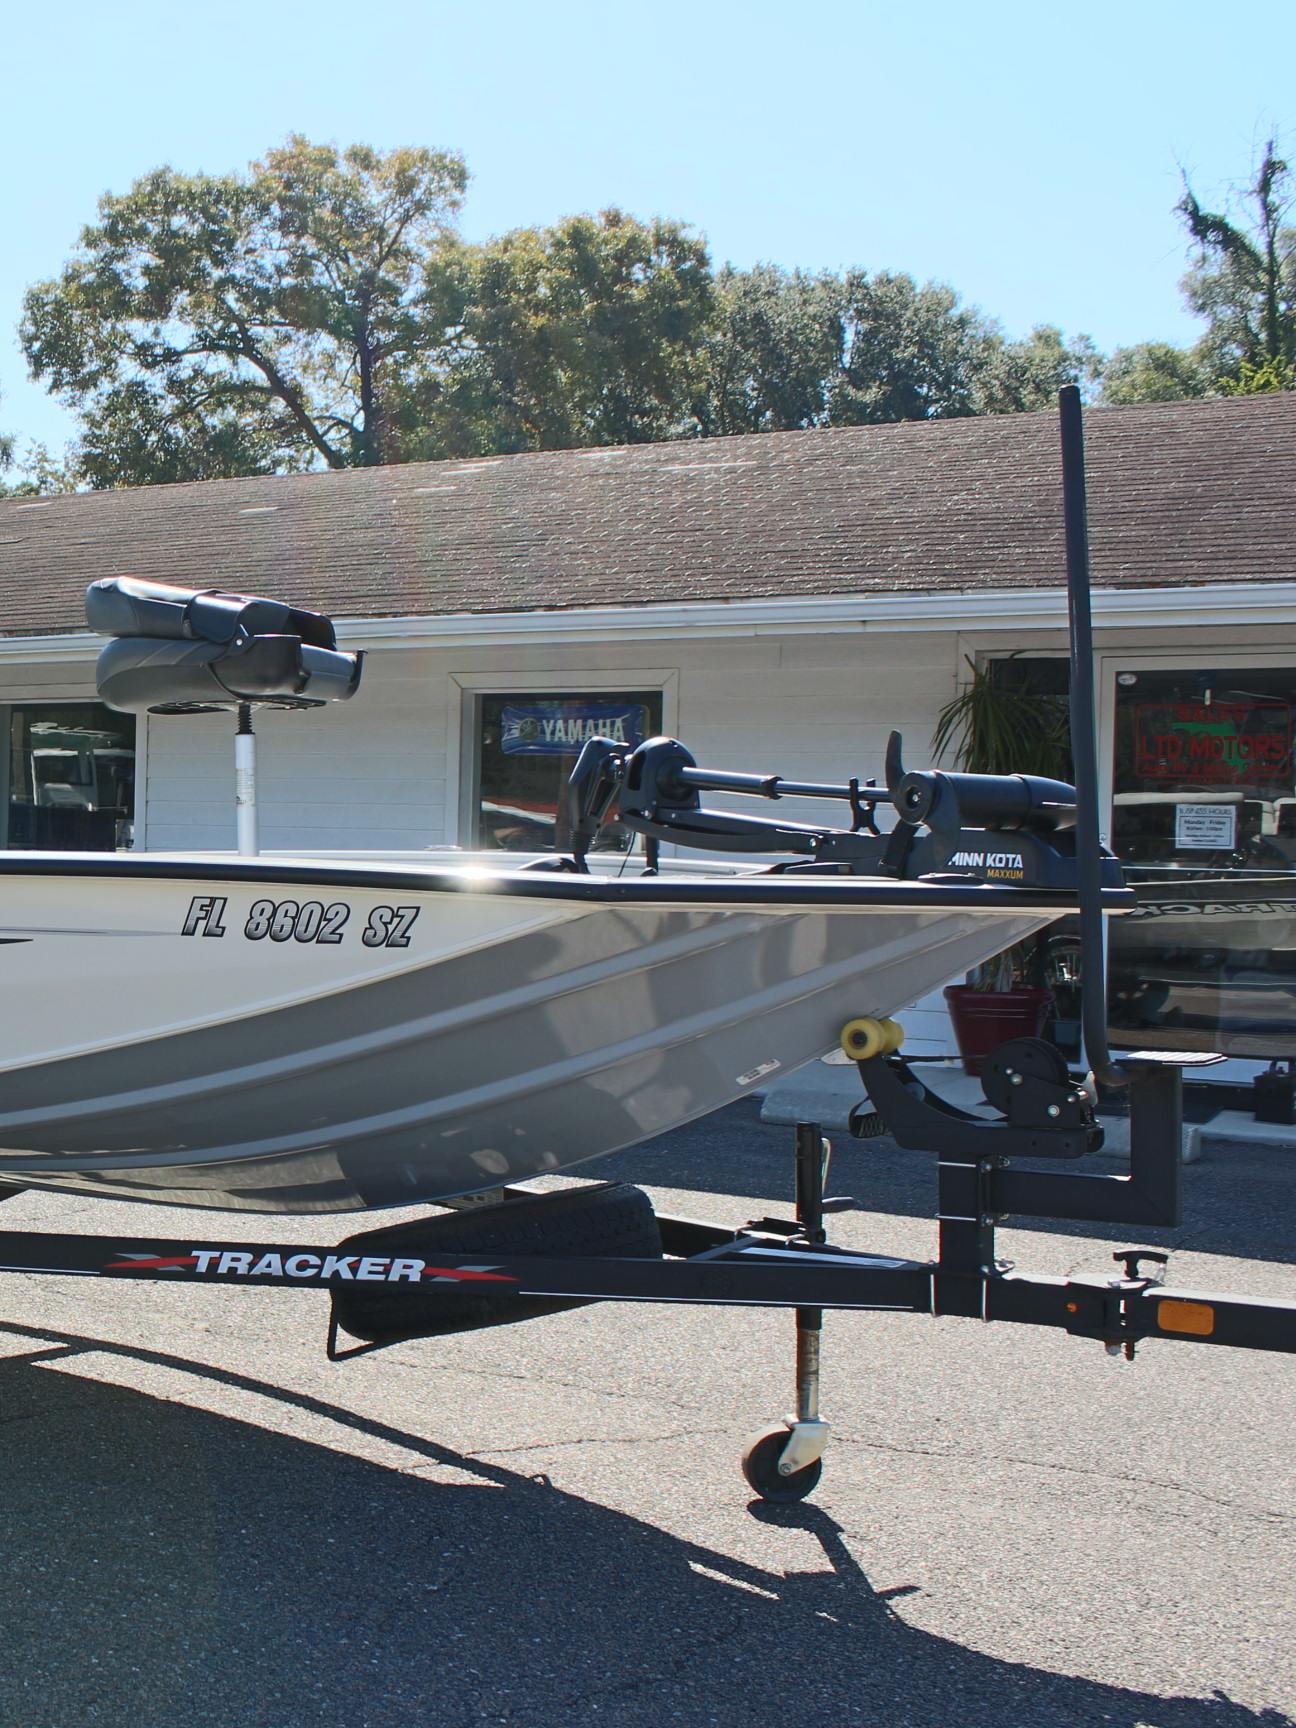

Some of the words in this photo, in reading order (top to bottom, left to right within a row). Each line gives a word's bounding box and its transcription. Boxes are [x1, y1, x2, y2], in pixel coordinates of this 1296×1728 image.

[542, 718, 625, 744] YAMAHA
[1141, 735, 1183, 760] LTD
[1188, 735, 1285, 760] MOTORS
[985, 853, 1023, 869] KOTA
[987, 868, 1024, 879] MAXXUM
[181, 896, 228, 937] FL
[244, 899, 350, 944] 8602
[361, 905, 421, 948] SZ
[190, 1250, 426, 1282] TRACKER
